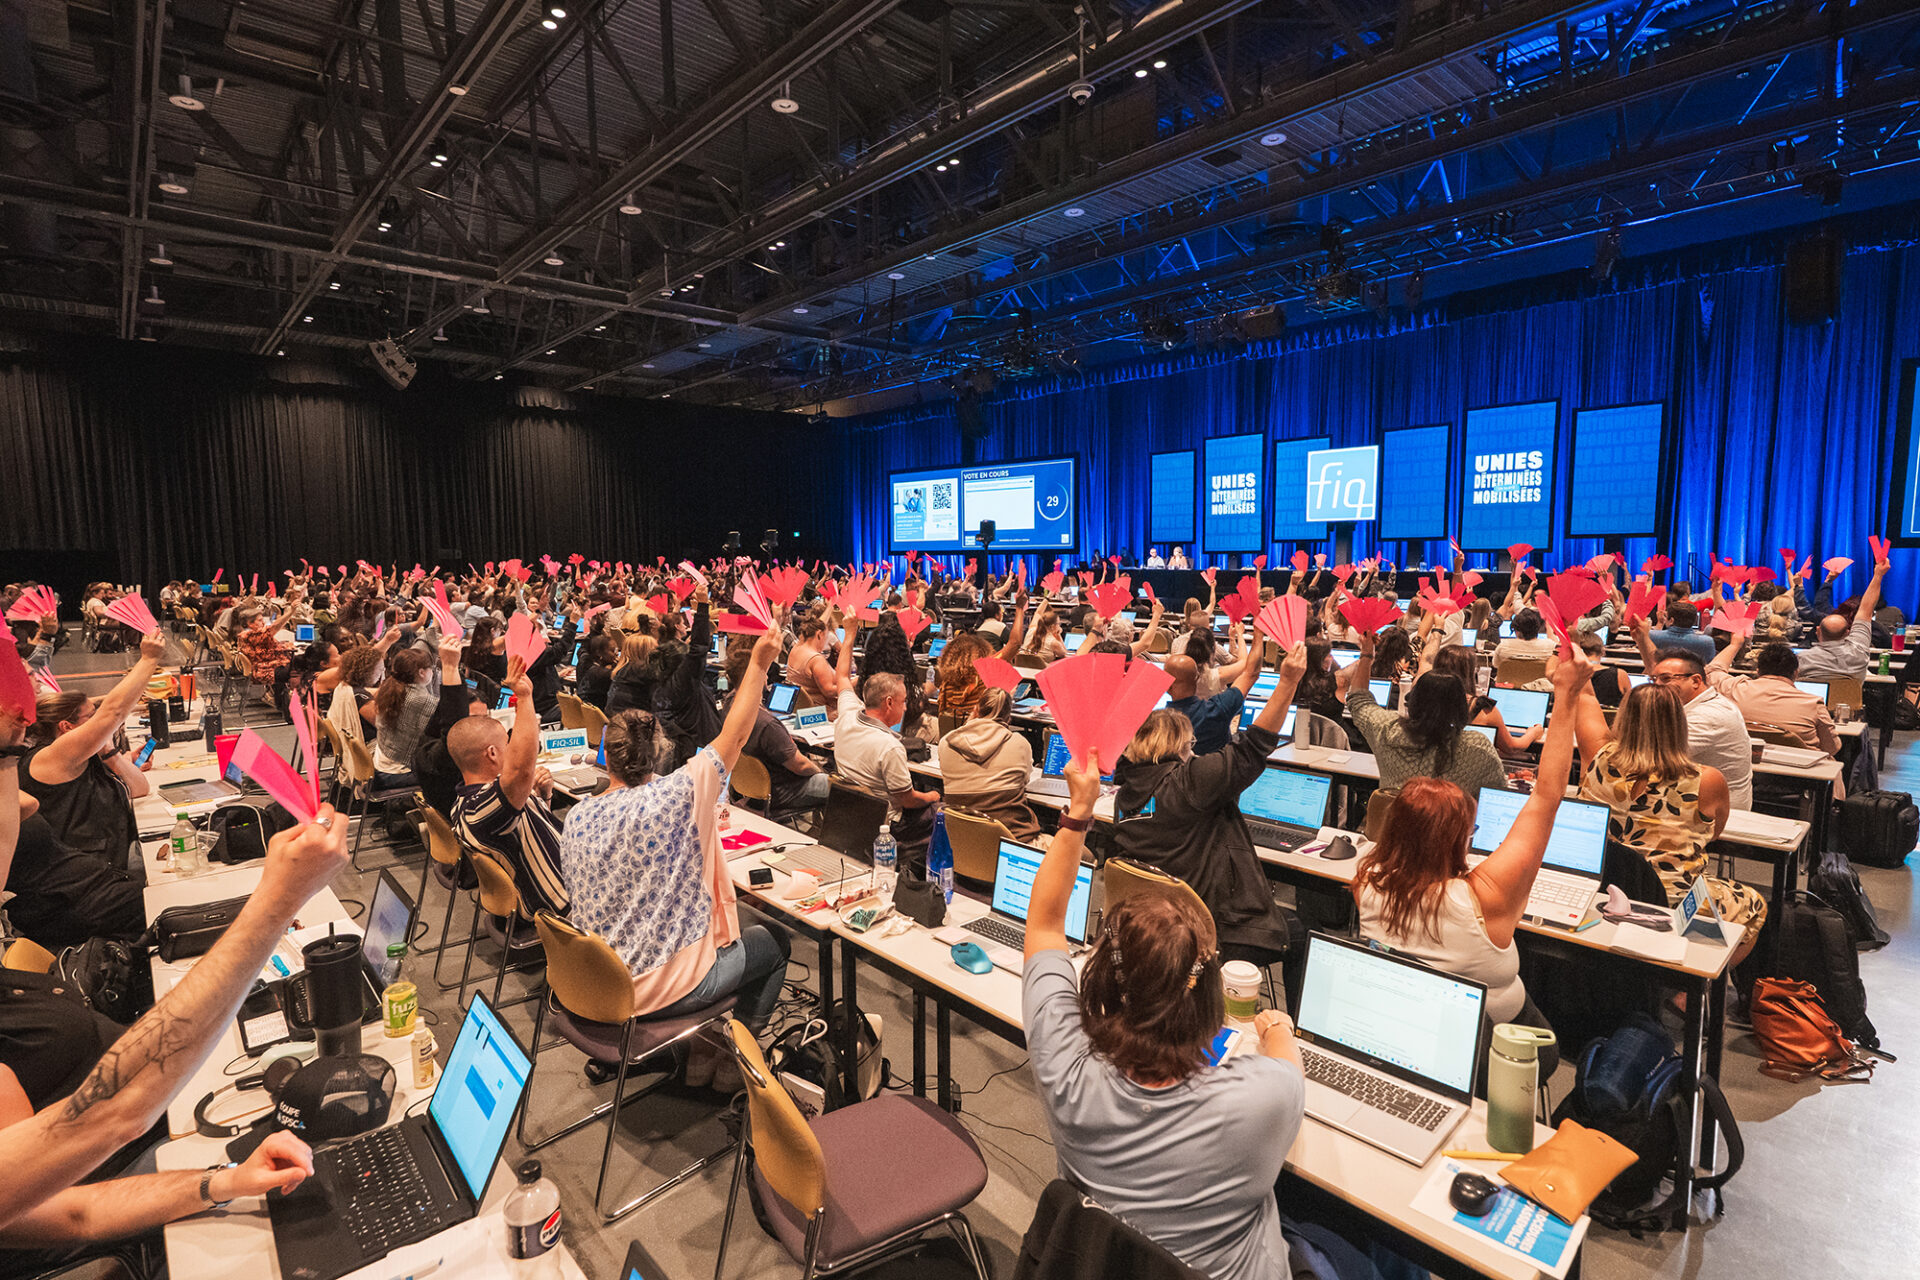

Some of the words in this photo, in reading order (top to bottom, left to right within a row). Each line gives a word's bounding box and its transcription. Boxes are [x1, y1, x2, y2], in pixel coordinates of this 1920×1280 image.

[1475, 451, 1543, 472] UNIES
[964, 472, 978, 480] VOTE
[989, 470, 1009, 478] COURS
[1212, 472, 1256, 490] UNIES
[1474, 469, 1542, 489] DÉTERMINÉES
[1310, 462, 1373, 519] fiq
[1473, 487, 1542, 504] MOBILISÉES
[1046, 495, 1059, 507] 29
[1211, 501, 1256, 516] MOBILISÉES
[804, 715, 823, 724] FIQ-SIL
[552, 738, 580, 748] FIQ-SIL
[392, 1000, 417, 1015] fuz
[1518, 1208, 1550, 1253] ROCÉDURES
